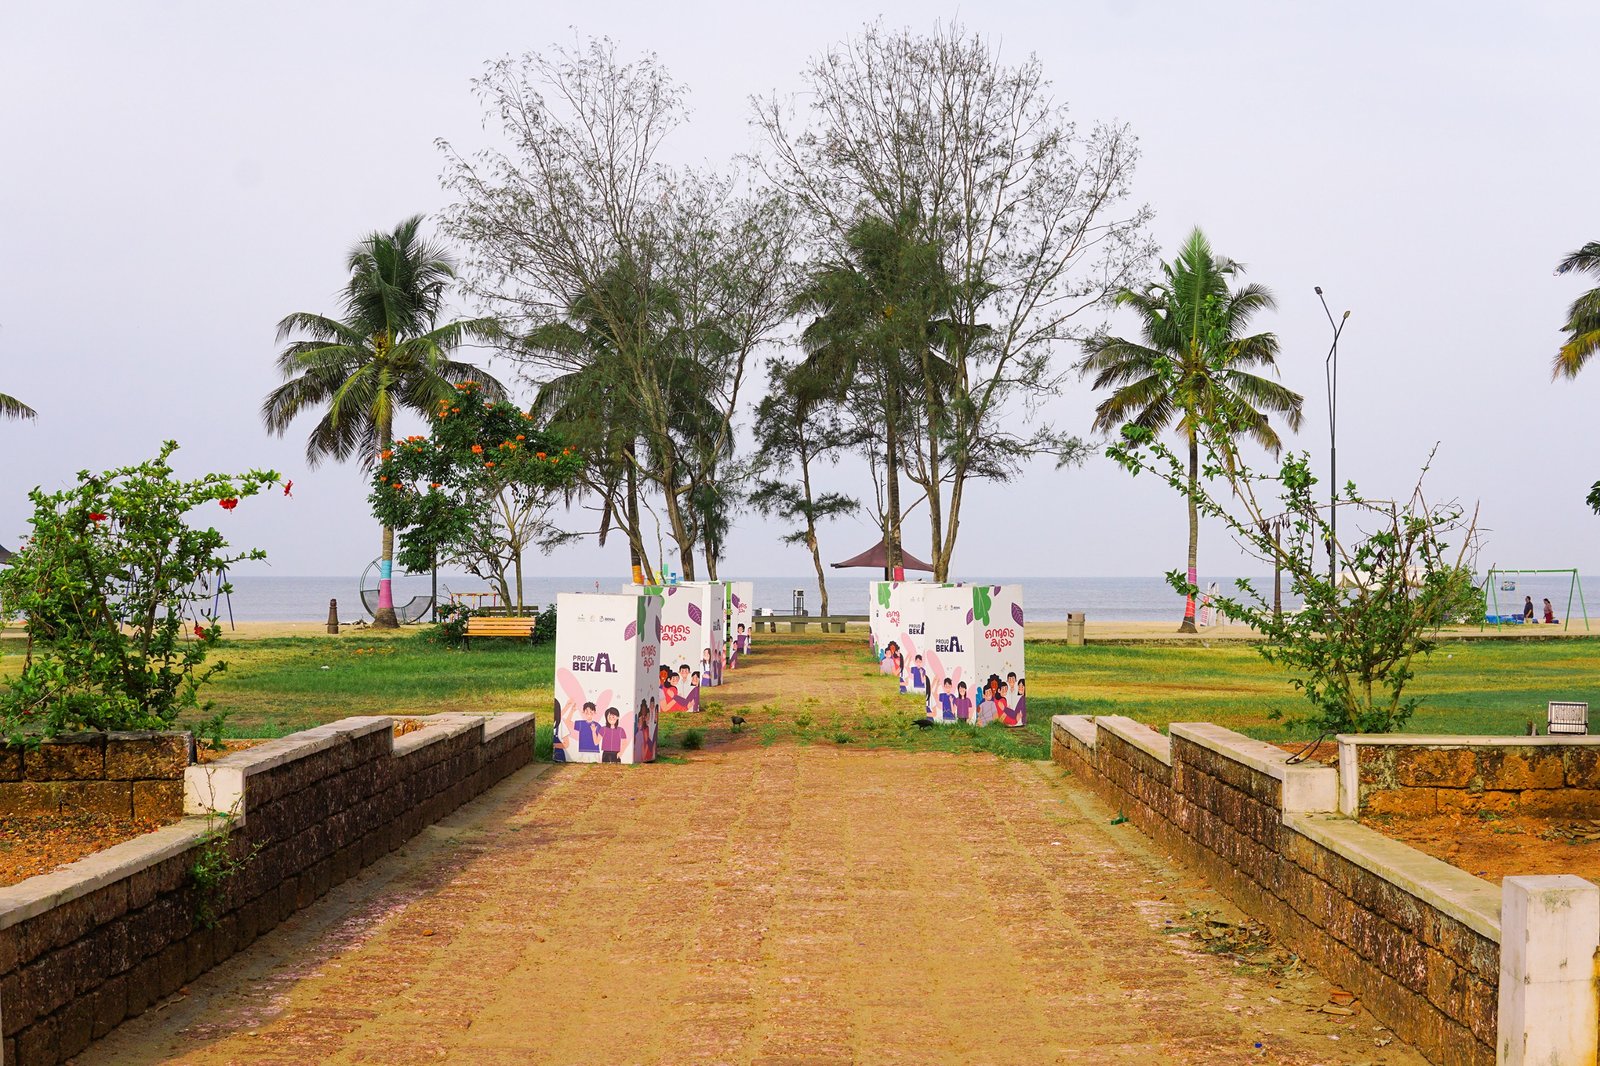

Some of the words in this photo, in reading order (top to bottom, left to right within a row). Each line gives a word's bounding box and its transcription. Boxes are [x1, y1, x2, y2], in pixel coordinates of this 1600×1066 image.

[908, 622, 925, 635] BEK
[936, 636, 964, 653] BEKAL
[572, 652, 618, 673] BEKAL
